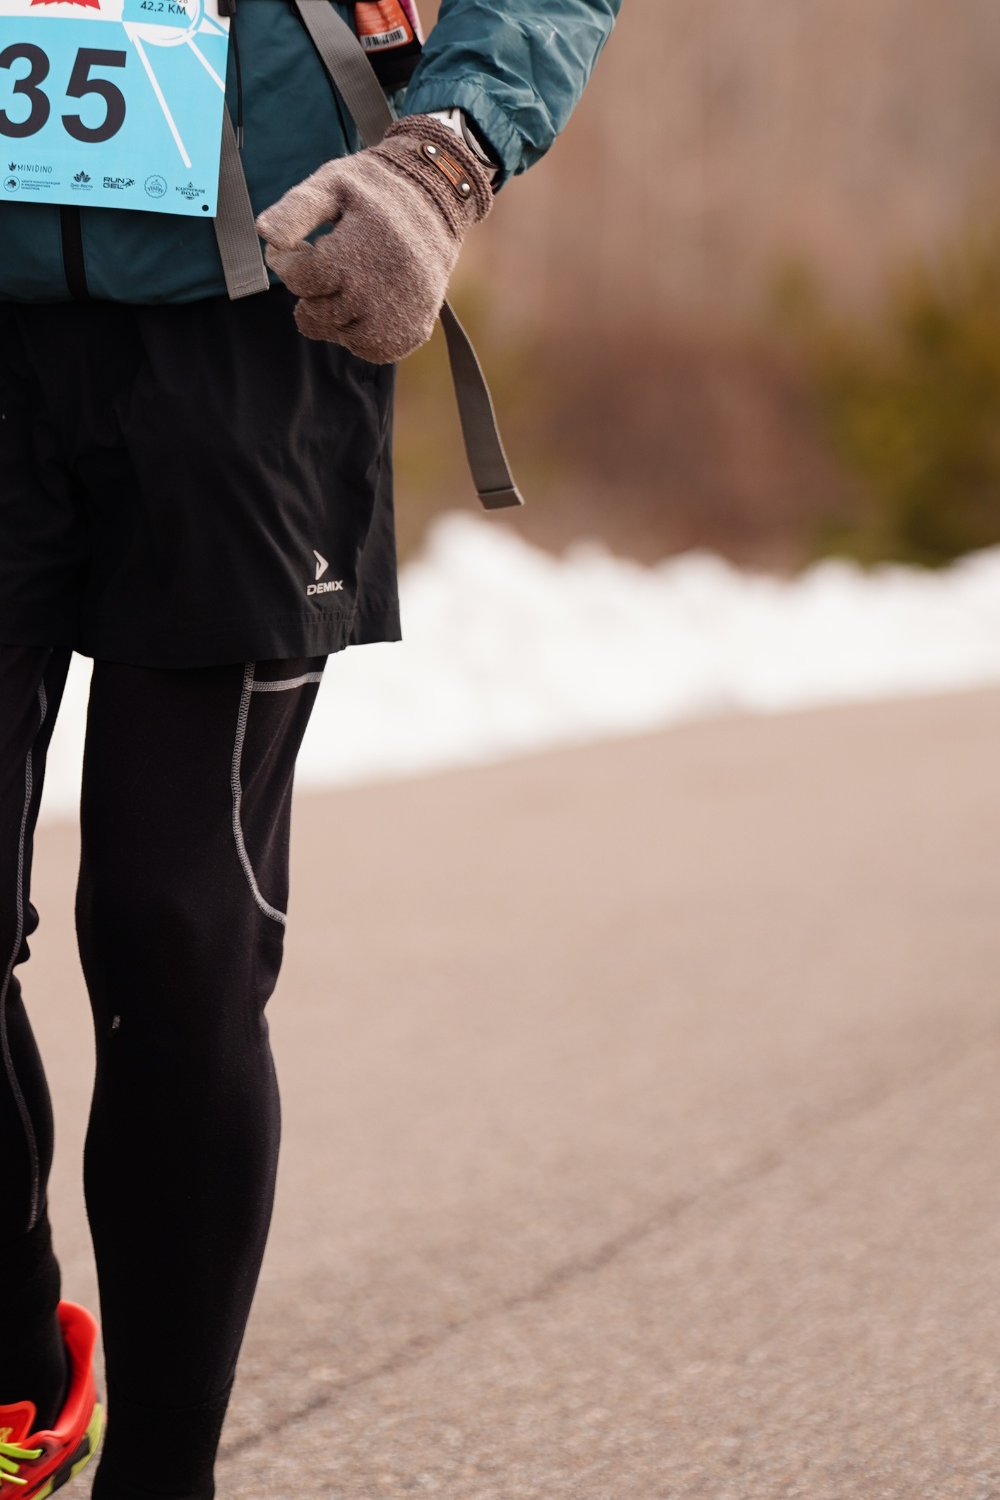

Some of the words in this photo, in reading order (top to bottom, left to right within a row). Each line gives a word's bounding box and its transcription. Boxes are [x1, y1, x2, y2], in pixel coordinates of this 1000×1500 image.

[17, 164, 53, 174] MINIDINO
[103, 176, 125, 184] RUN
[103, 182, 125, 190] GEL
[306, 580, 343, 596] DEMIX
